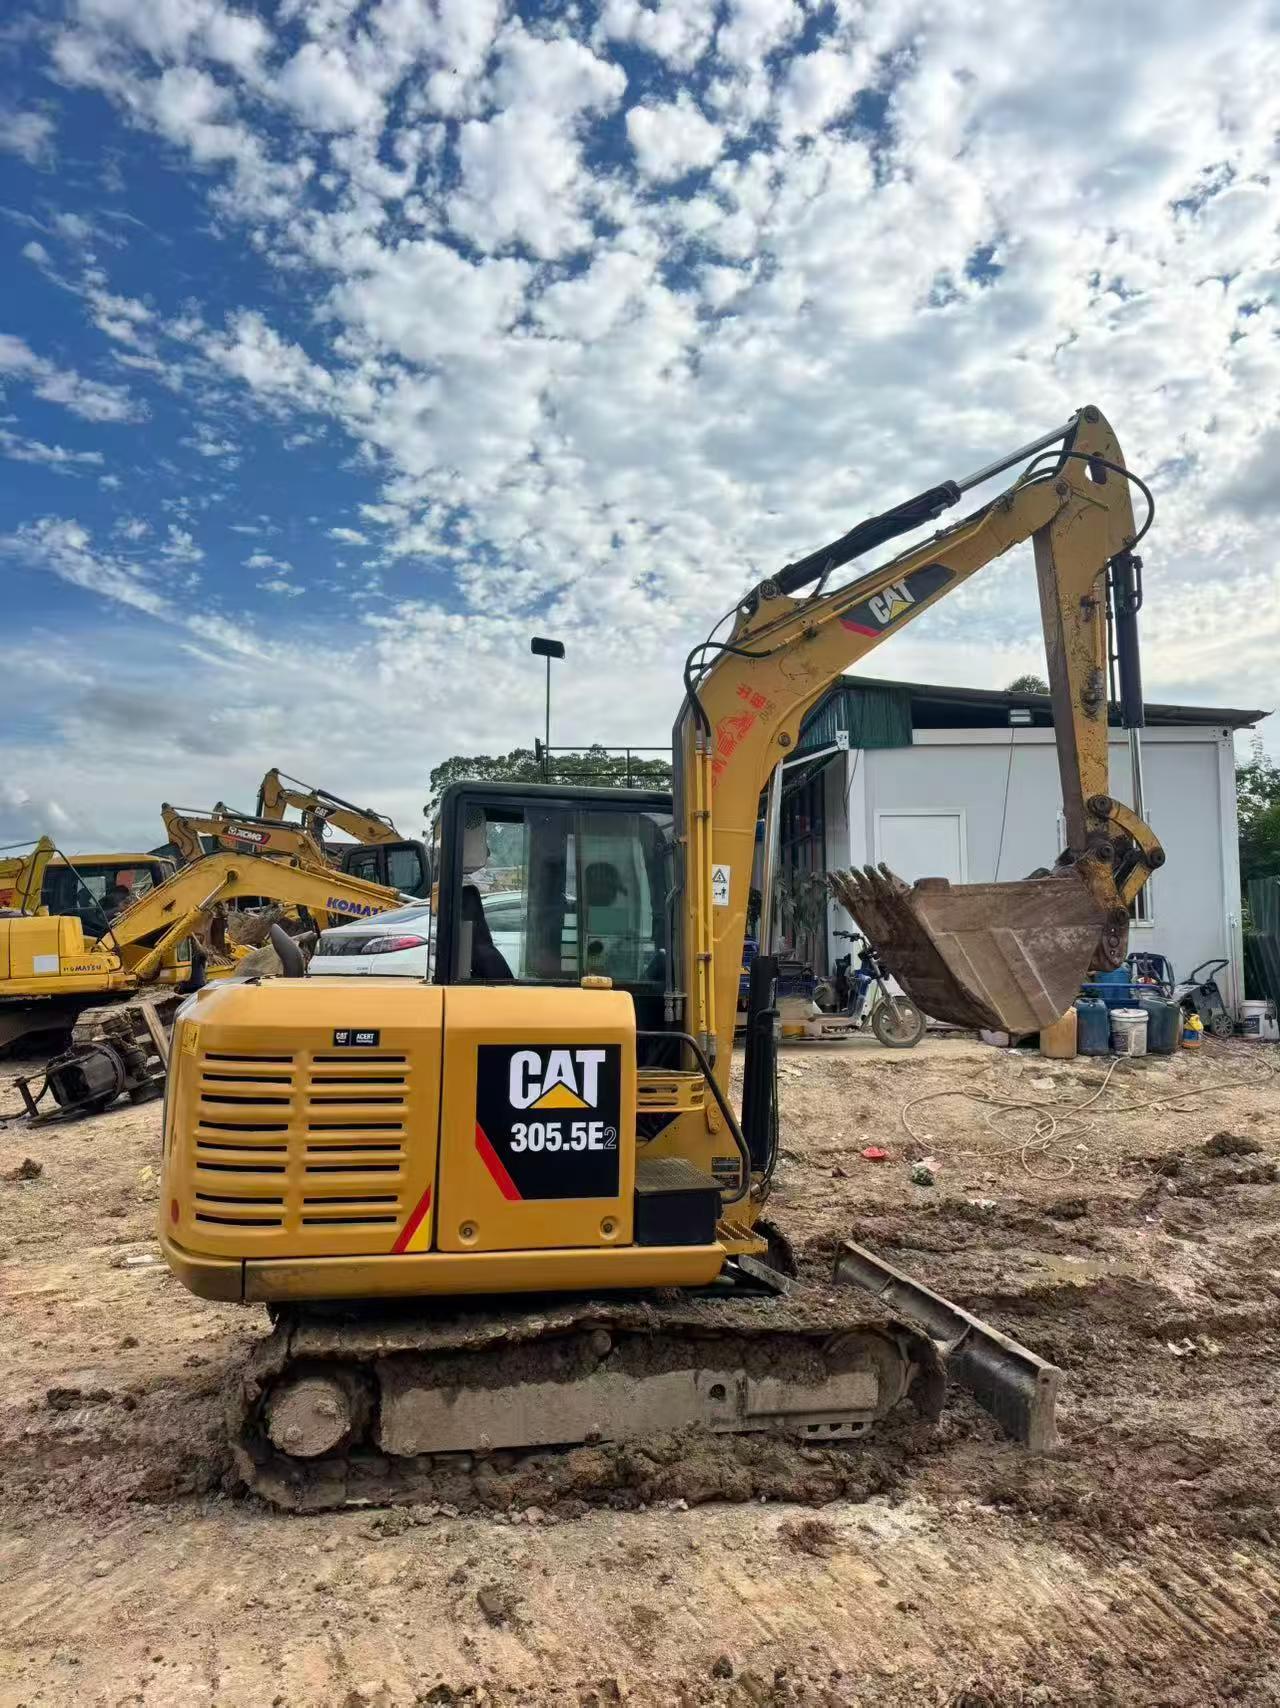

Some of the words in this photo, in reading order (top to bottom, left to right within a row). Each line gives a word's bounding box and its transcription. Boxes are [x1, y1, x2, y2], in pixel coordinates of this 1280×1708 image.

[868, 578, 915, 624] CAT
[326, 896, 387, 916] KOMAT
[509, 1050, 605, 1109] CAT
[510, 1121, 616, 1152] 305.5E2
